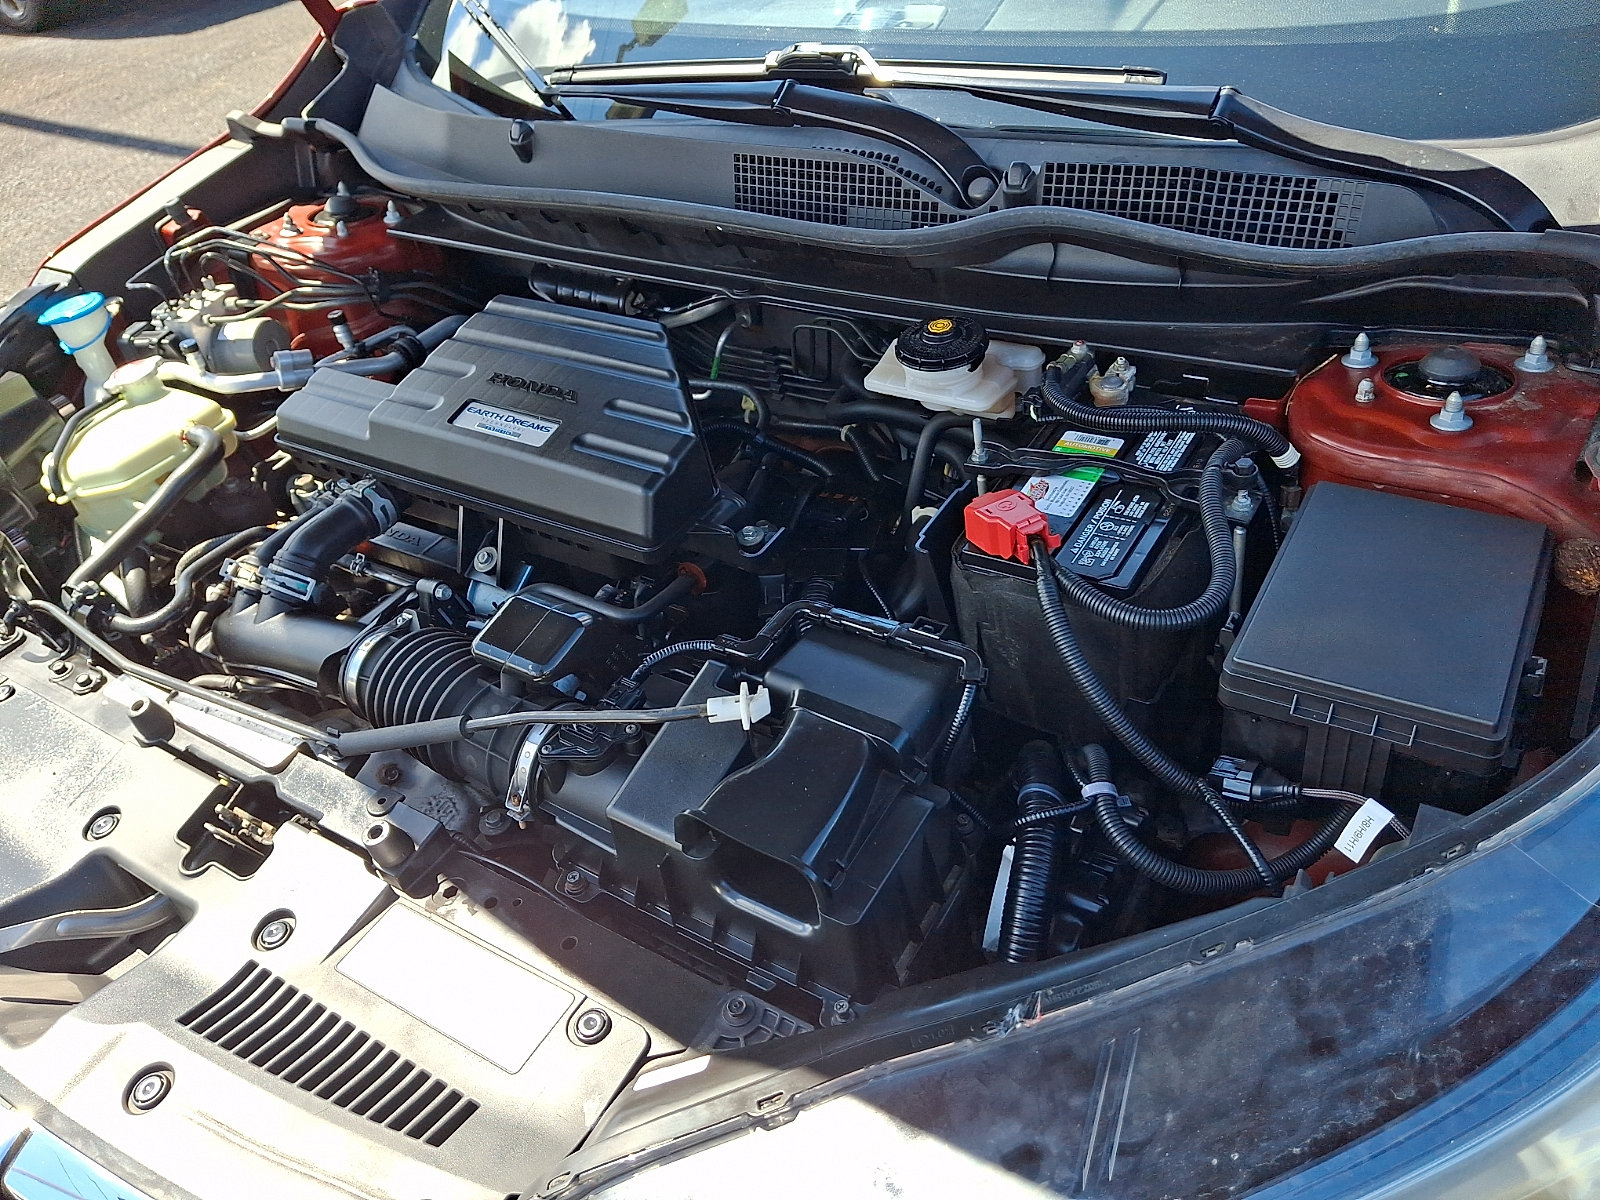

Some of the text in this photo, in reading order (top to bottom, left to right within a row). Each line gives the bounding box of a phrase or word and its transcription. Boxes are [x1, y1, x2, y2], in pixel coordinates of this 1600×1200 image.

[487, 372, 578, 404] HONDA
[466, 406, 552, 433] EARTH DREAMS
[1064, 441, 1111, 454] AUTOMOTIVE
[1074, 523, 1096, 549] DANGER
[1093, 498, 1112, 520] POISON
